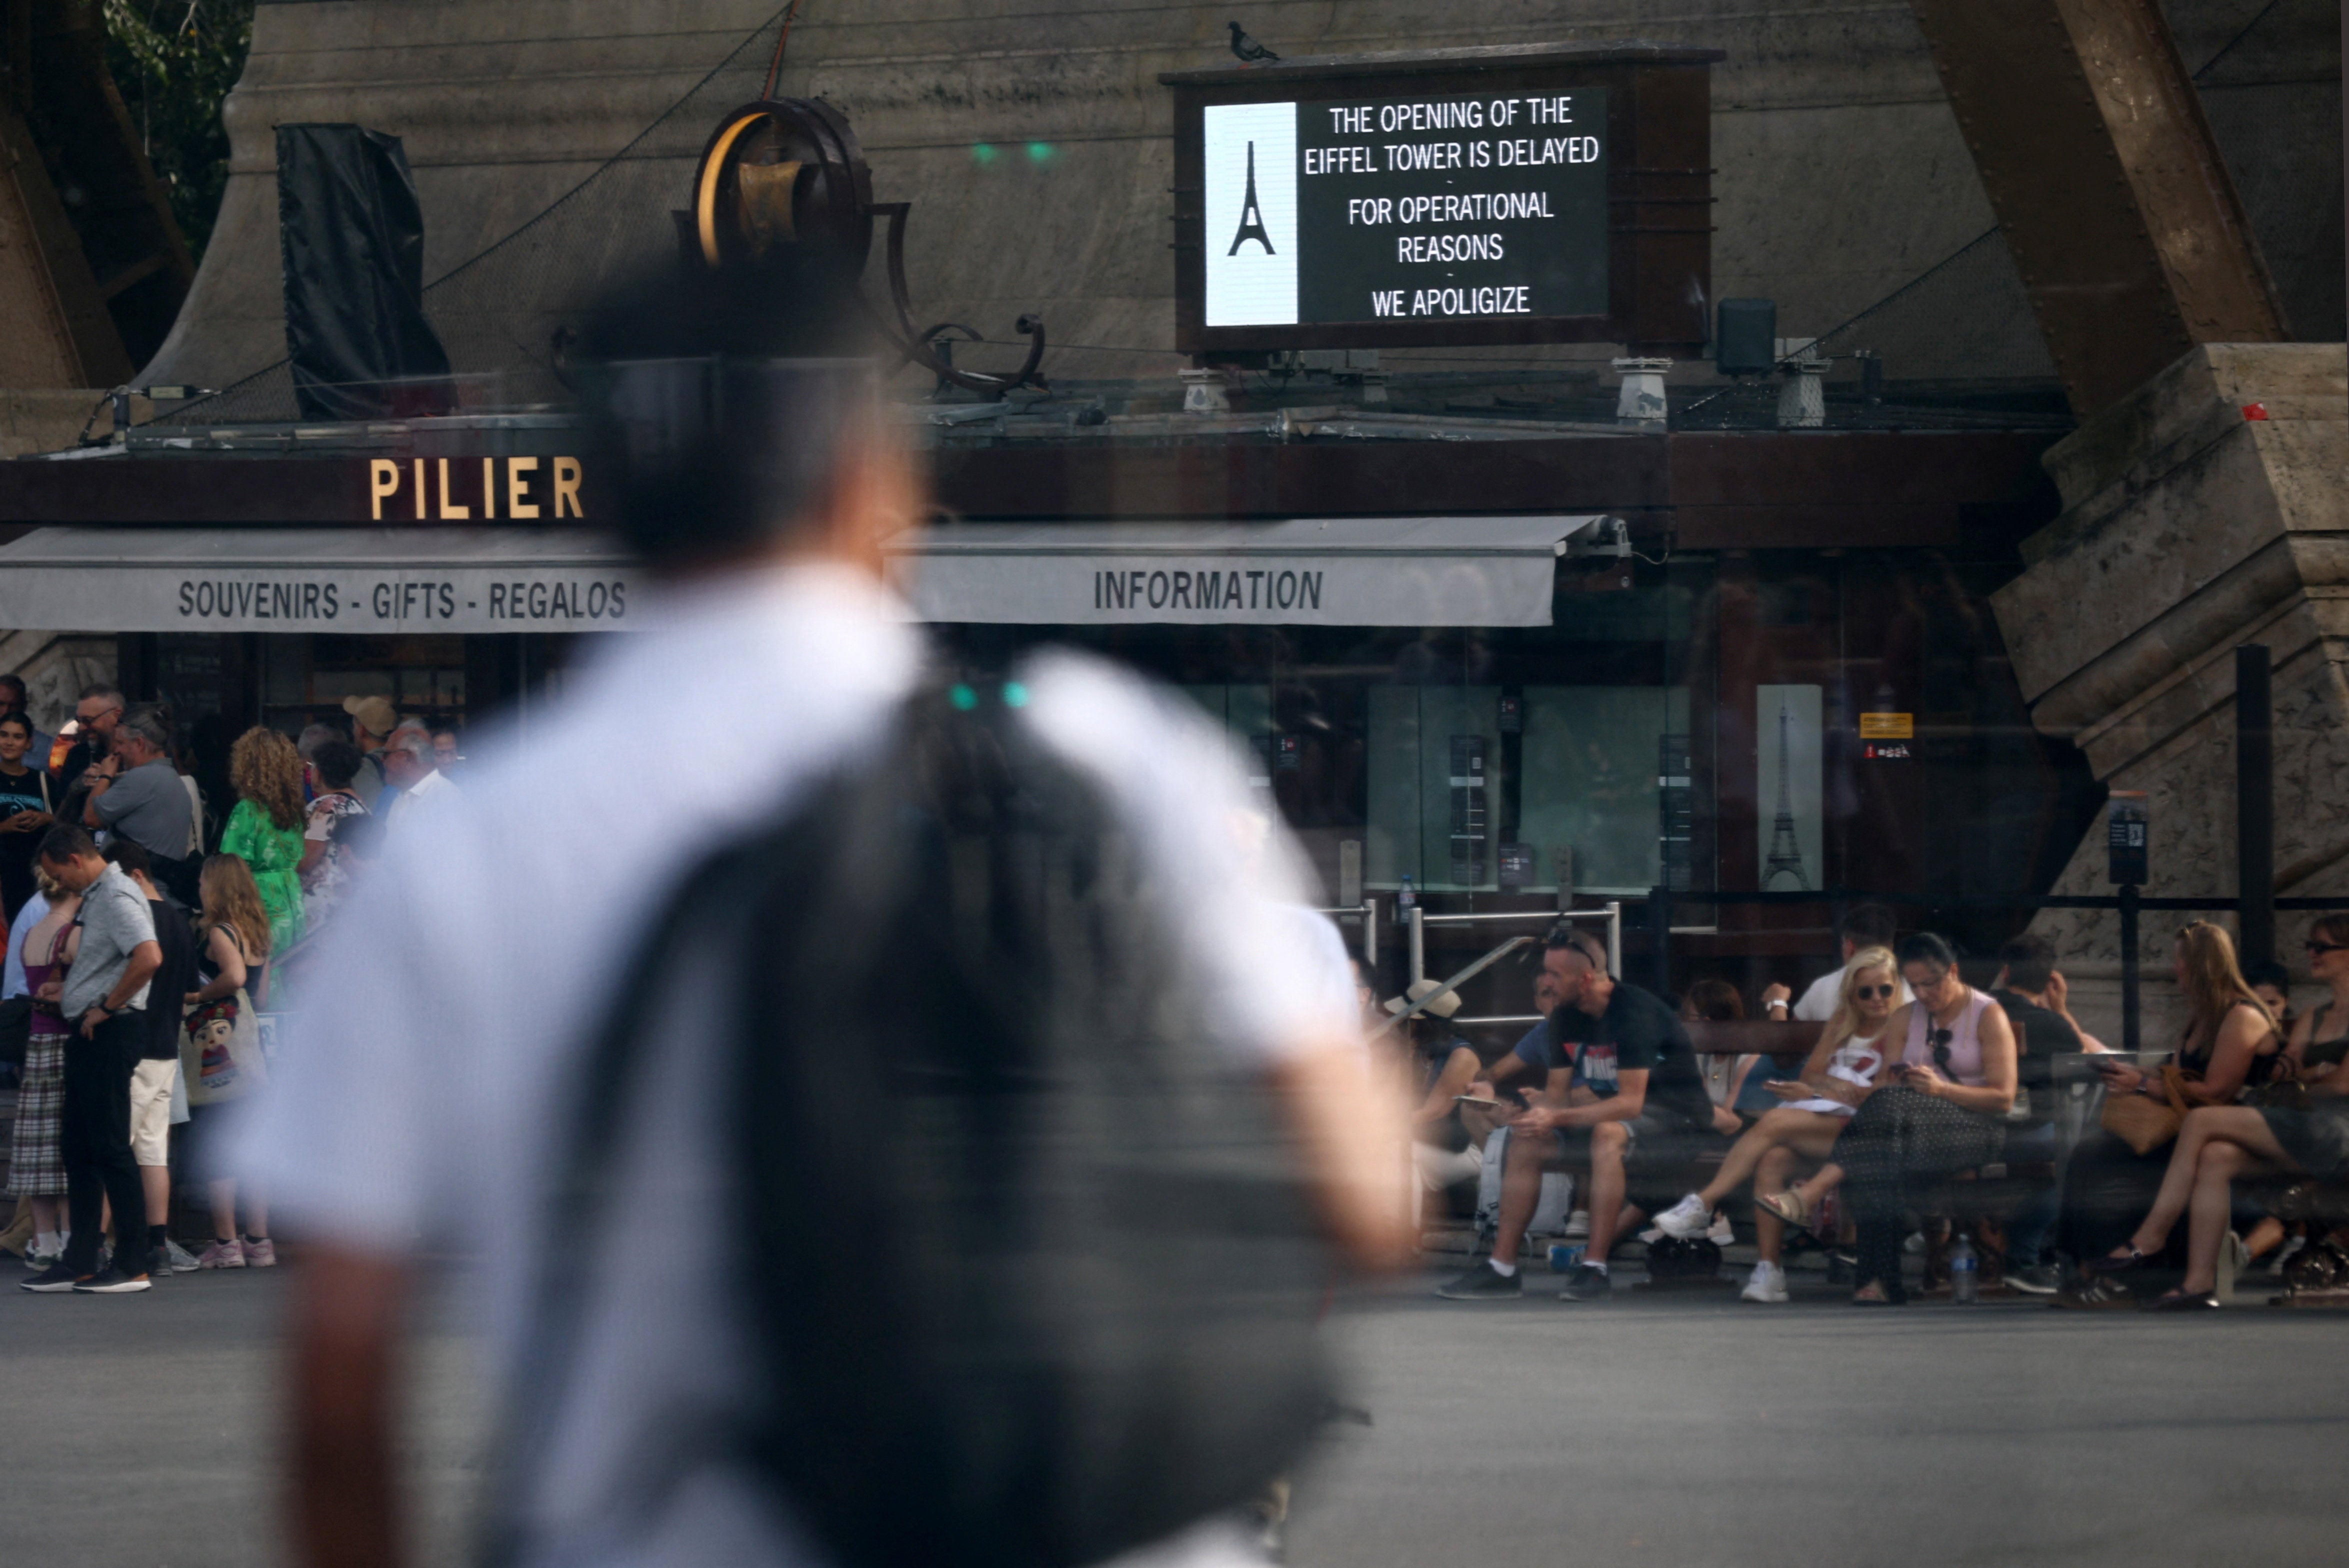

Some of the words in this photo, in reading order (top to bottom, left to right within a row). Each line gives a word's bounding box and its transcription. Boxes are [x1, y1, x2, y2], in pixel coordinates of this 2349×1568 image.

[1329, 106, 1374, 133] THE
[1380, 101, 1482, 132] OPENING
[1490, 99, 1520, 127] OF
[1526, 96, 1572, 124] THE
[1305, 146, 1378, 174] EIFFEL
[1384, 142, 1461, 171] TOWER
[1470, 140, 1490, 167] IS
[1498, 136, 1598, 166] DELAYED
[1350, 198, 1392, 225] FOR
[1399, 191, 1554, 224] OPERATIONAL
[1398, 233, 1504, 263] REASONS
[1372, 290, 1406, 317] WE
[1412, 286, 1530, 315] APOLIGIZE
[370, 457, 582, 520] PILIER
[178, 581, 339, 619] SOUVENIRS
[372, 582, 455, 619] GIFTS
[490, 582, 625, 619] REGALOS
[1094, 570, 1323, 610] INFORMATION
